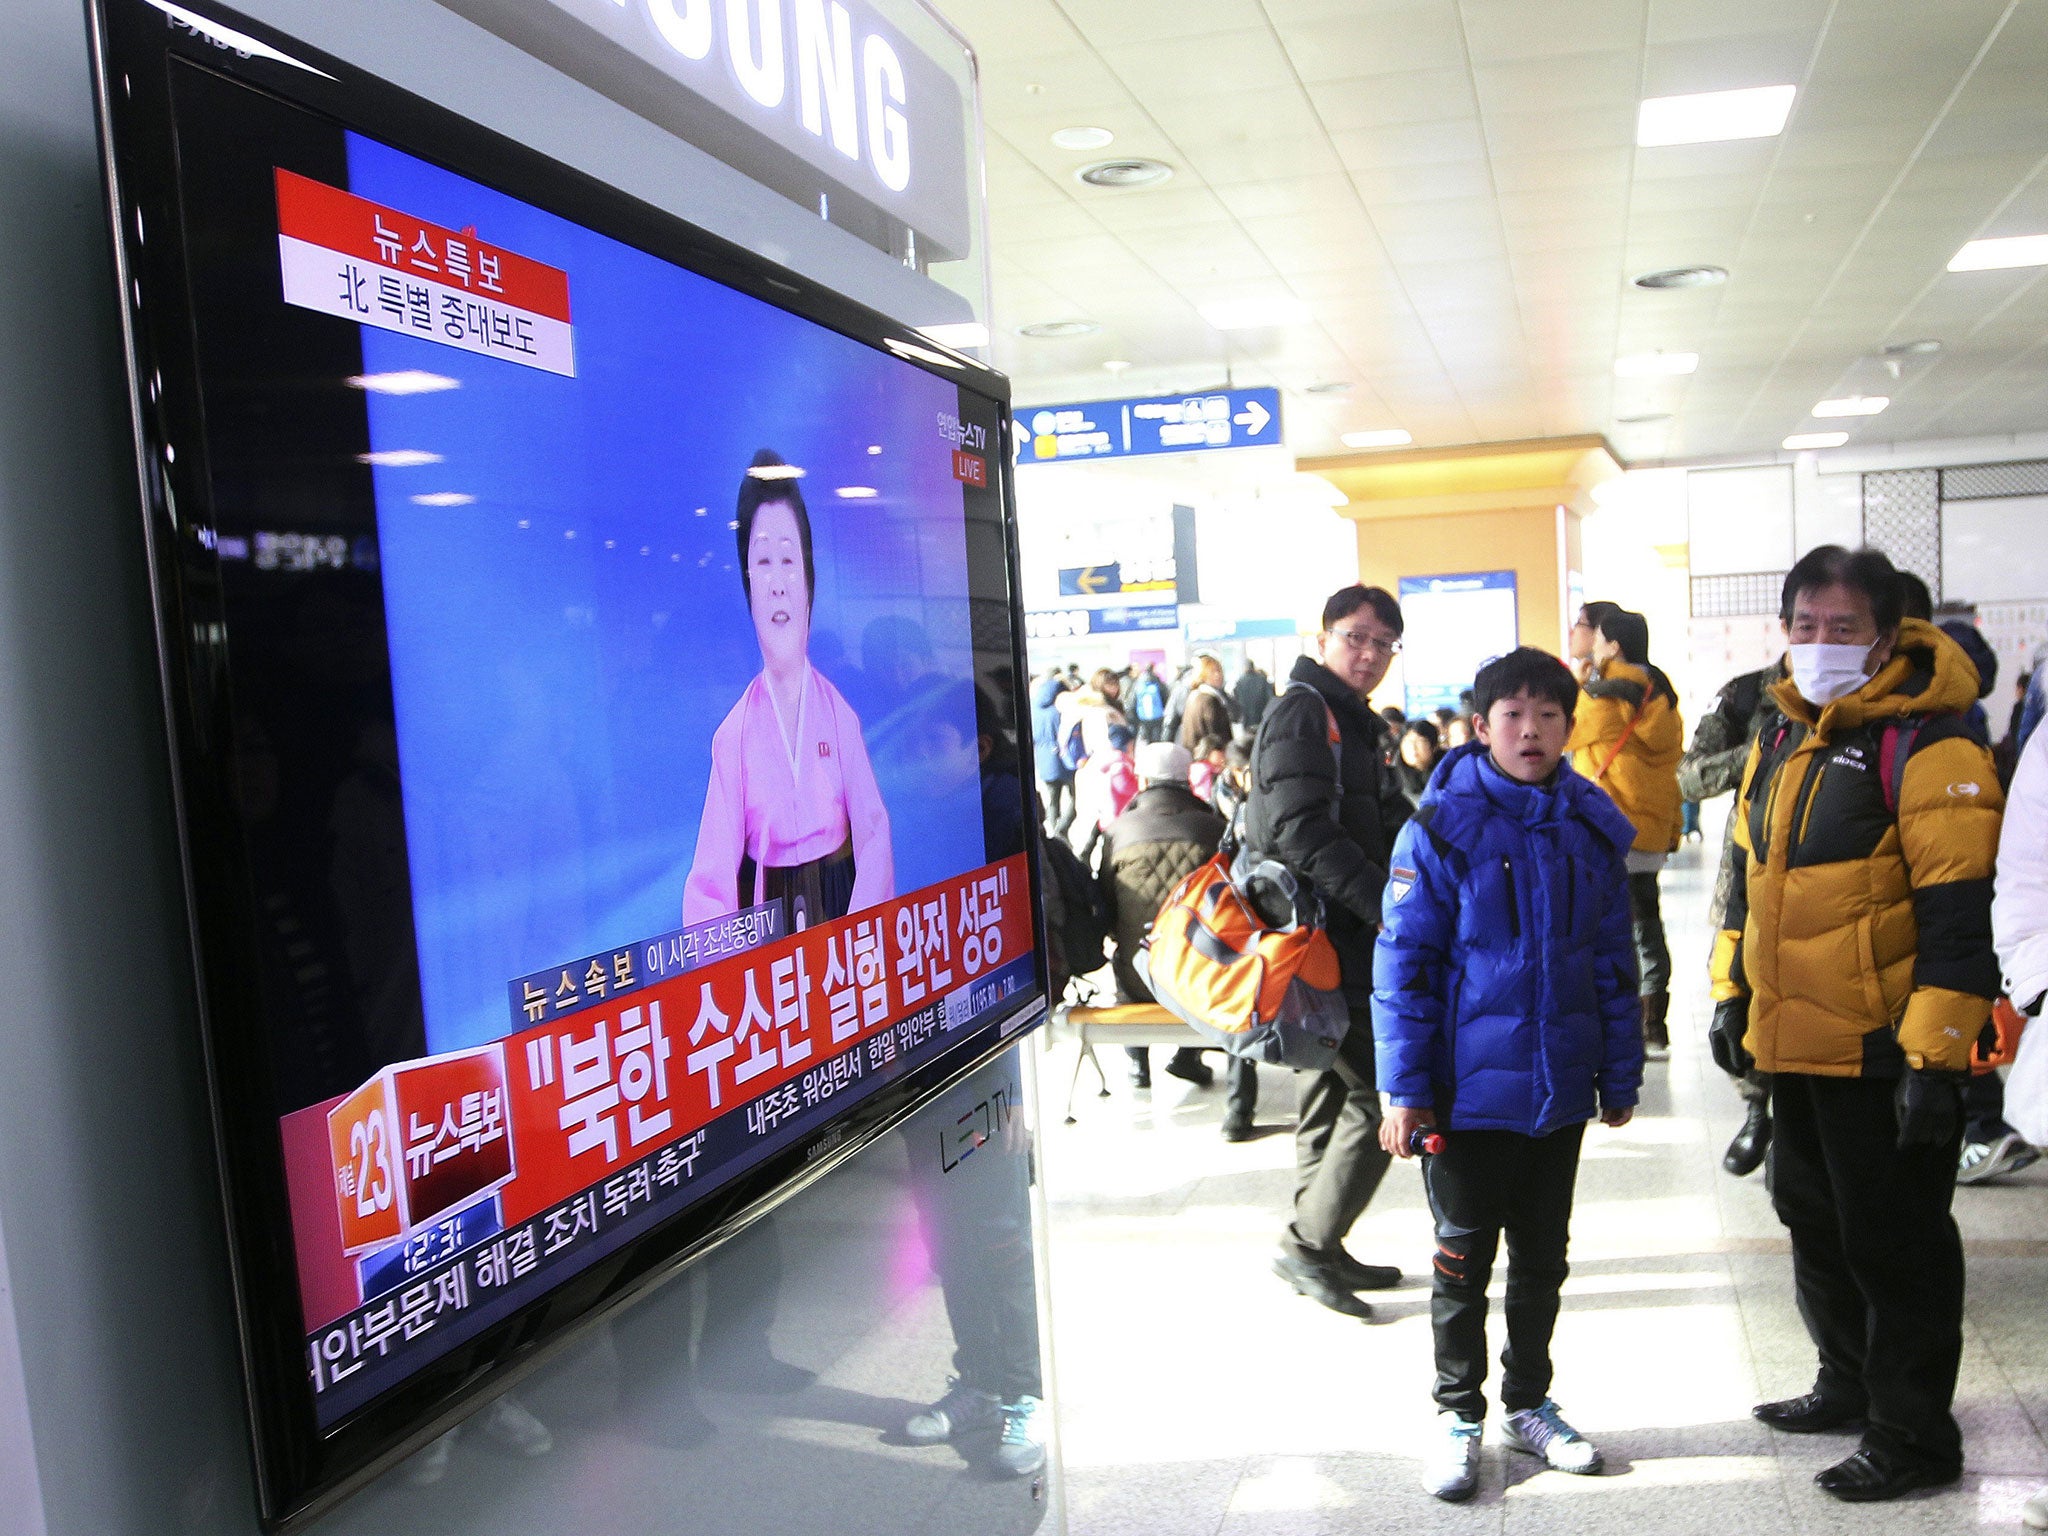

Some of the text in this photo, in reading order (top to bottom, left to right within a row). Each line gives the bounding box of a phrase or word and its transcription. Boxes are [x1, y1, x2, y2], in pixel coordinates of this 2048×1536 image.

[371, 213, 504, 294] 뉴스특보
[337, 263, 537, 356] 北 특별 중대보도
[959, 456, 980, 481] LIVE
[522, 908, 776, 1022] 뉴스속보 이 시각 조선중앙TV
[525, 865, 1009, 1165] "북한 수소탄 실험 완전 성공"
[350, 1109, 393, 1218] 23
[406, 1086, 505, 1181] 뉴스특보
[475, 1228, 539, 1289] 해결
[543, 1191, 599, 1258] 조치
[746, 1080, 801, 1137] 내주초
[802, 1054, 862, 1108] 워싱턴서
[867, 1029, 896, 1071] 한일
[806, 1129, 842, 1162] SAMSUNG
[403, 1216, 463, 1274] 12:31
